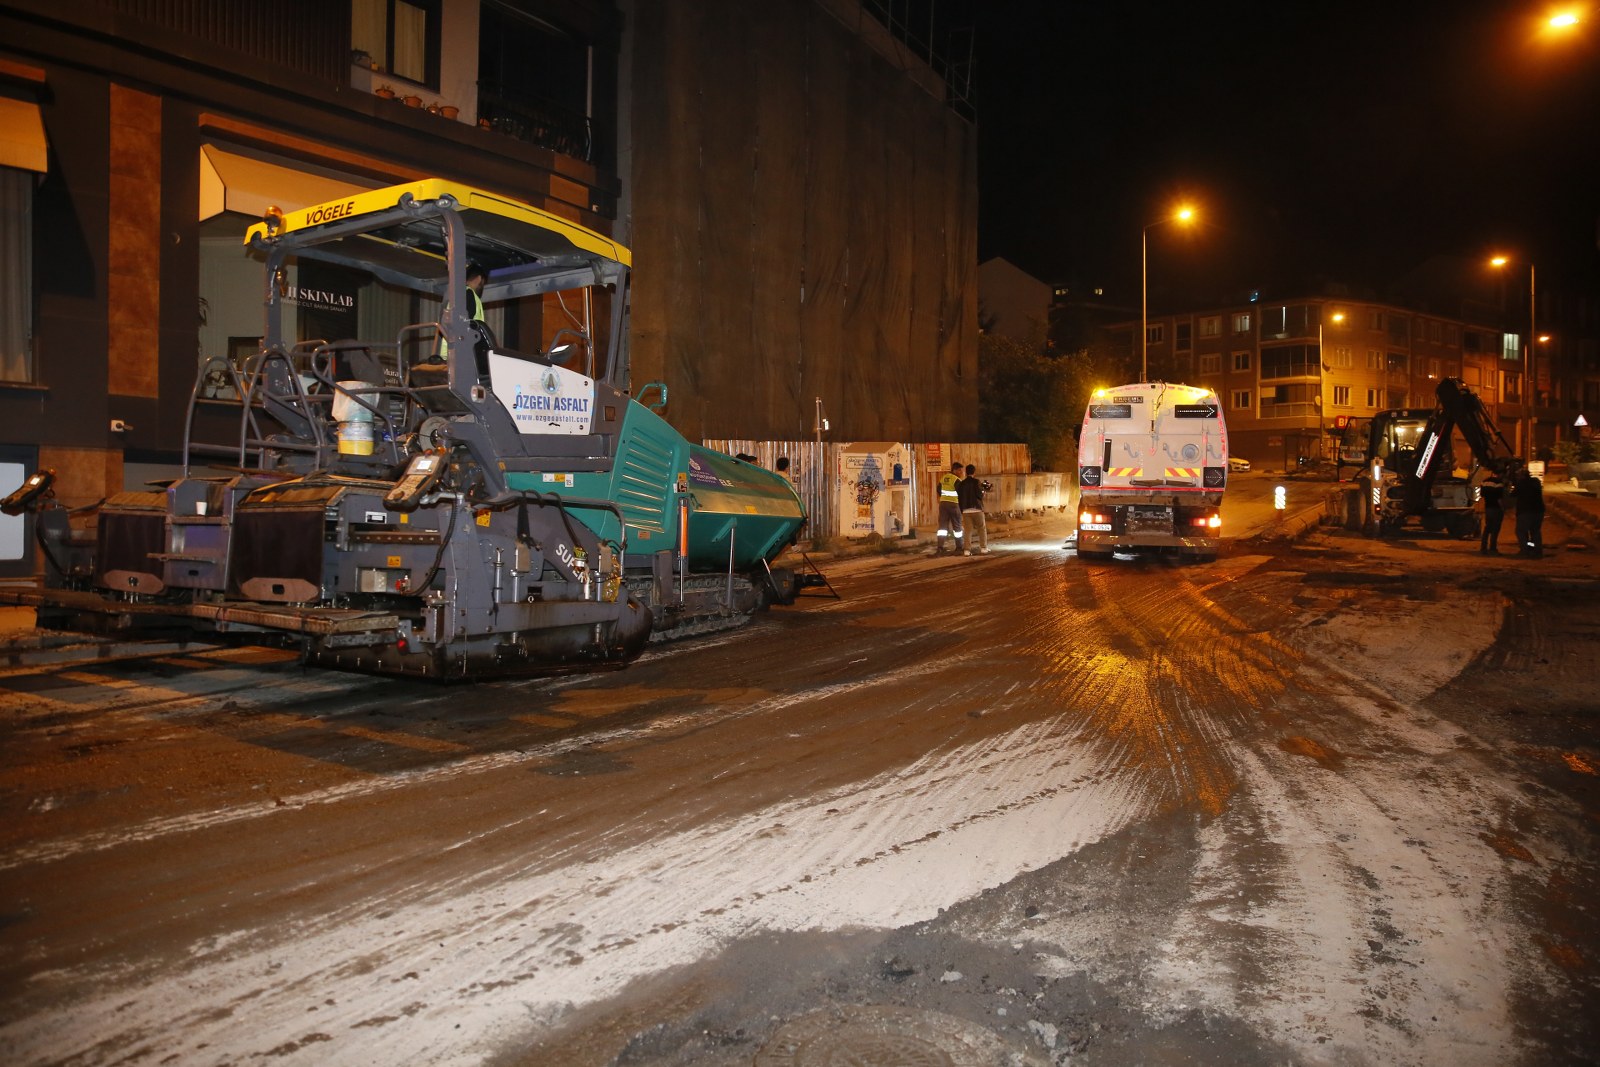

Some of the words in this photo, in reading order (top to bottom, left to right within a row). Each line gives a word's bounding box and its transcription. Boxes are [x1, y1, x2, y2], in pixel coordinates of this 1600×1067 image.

[306, 202, 355, 225] VÖGELE
[299, 287, 354, 307] SKINLAB
[515, 391, 551, 411] ÖZGEN
[553, 396, 589, 412] ASFALT
